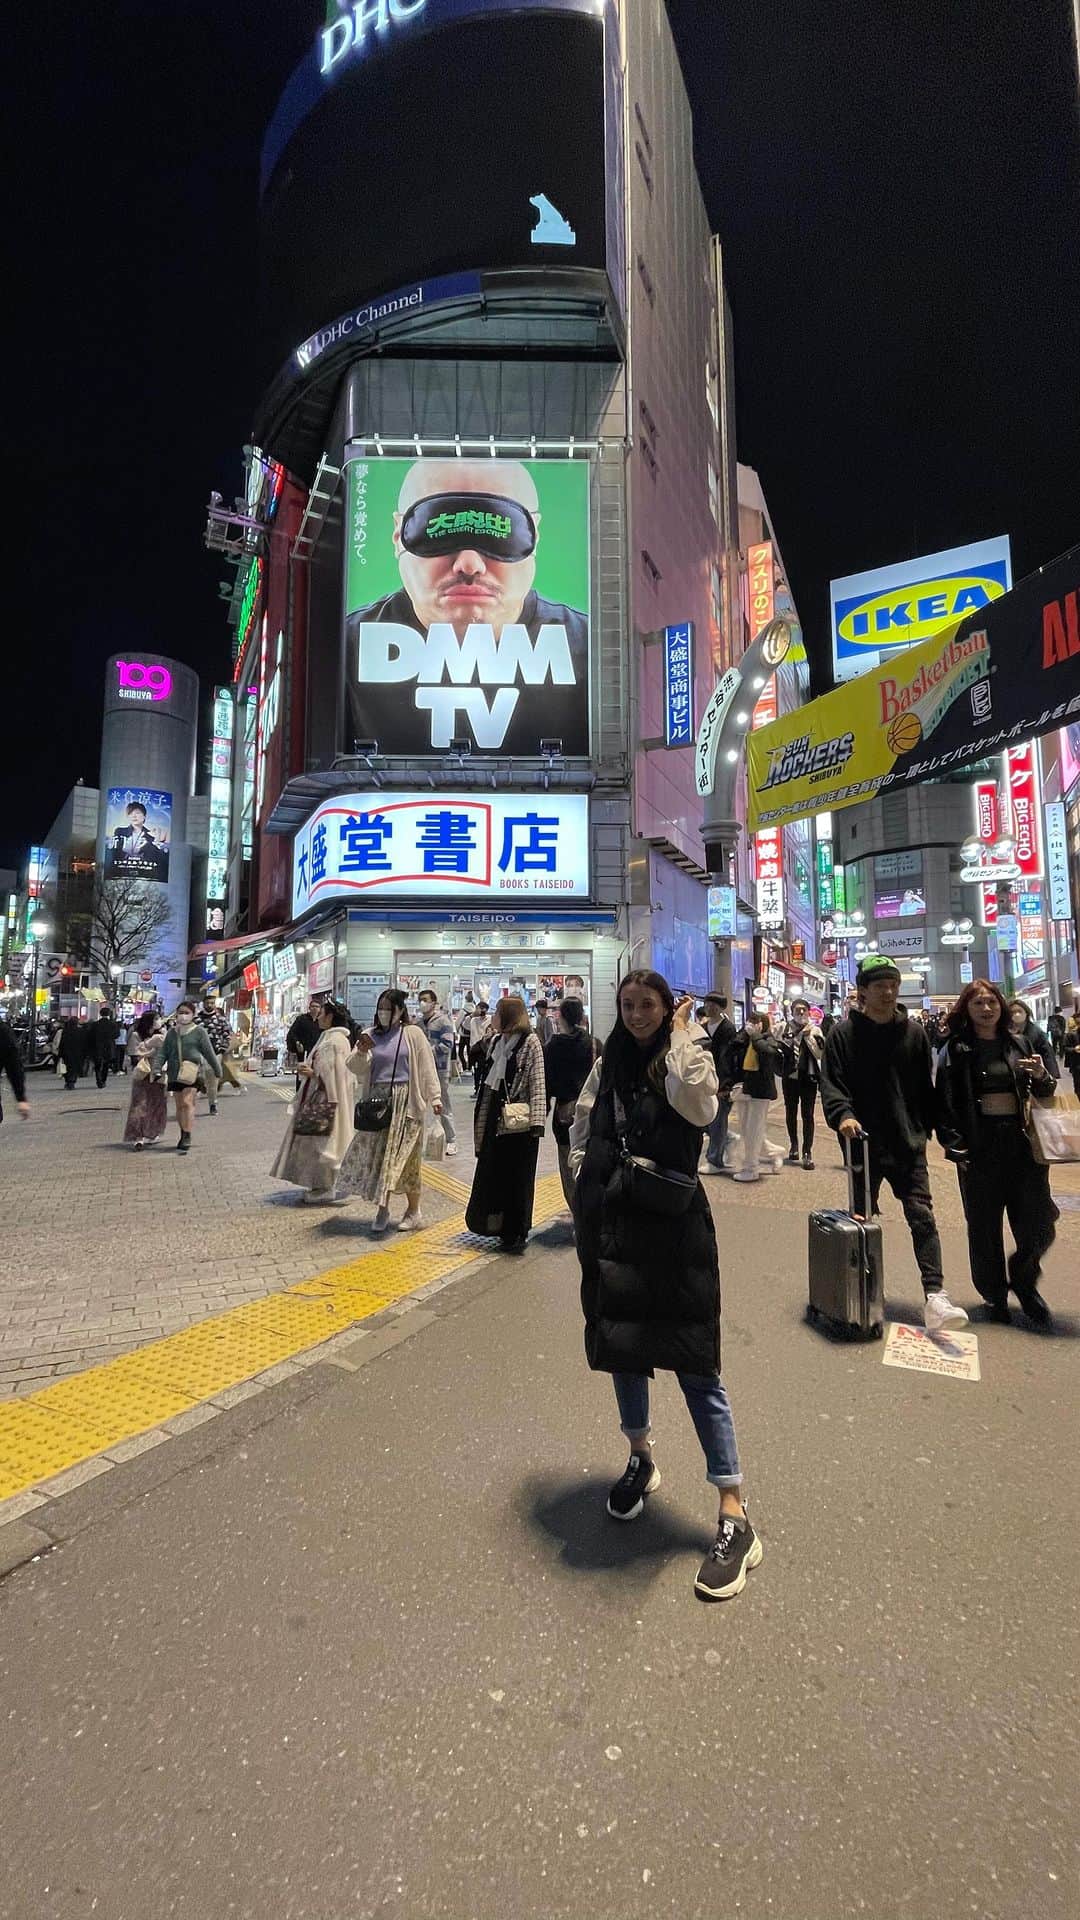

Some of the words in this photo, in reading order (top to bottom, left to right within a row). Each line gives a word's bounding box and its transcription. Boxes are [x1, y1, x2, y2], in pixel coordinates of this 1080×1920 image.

[356, 287, 423, 326] Channel
[354, 464, 369, 565] 夢なら覚めて。
[426, 510, 512, 535] 大脱出
[853, 585, 990, 637] IKEA
[358, 622, 577, 686] DMM
[880, 633, 988, 725] Basketball
[116, 660, 171, 701] 109
[118, 688, 152, 701] SHIBUYA
[669, 631, 689, 740] 大盛堂商事ビル
[415, 686, 520, 749] TV
[698, 673, 735, 792] 渋谷センター街
[756, 731, 855, 792] ROCKERS
[808, 765, 842, 785] SHIBUYA
[296, 811, 560, 899] 大盛堂書店
[499, 879, 530, 889] BOOKS
[533, 879, 574, 889] TAISEIDO
[449, 914, 516, 923] TAISEIDO
[466, 935, 545, 946] 大盛堂書店
